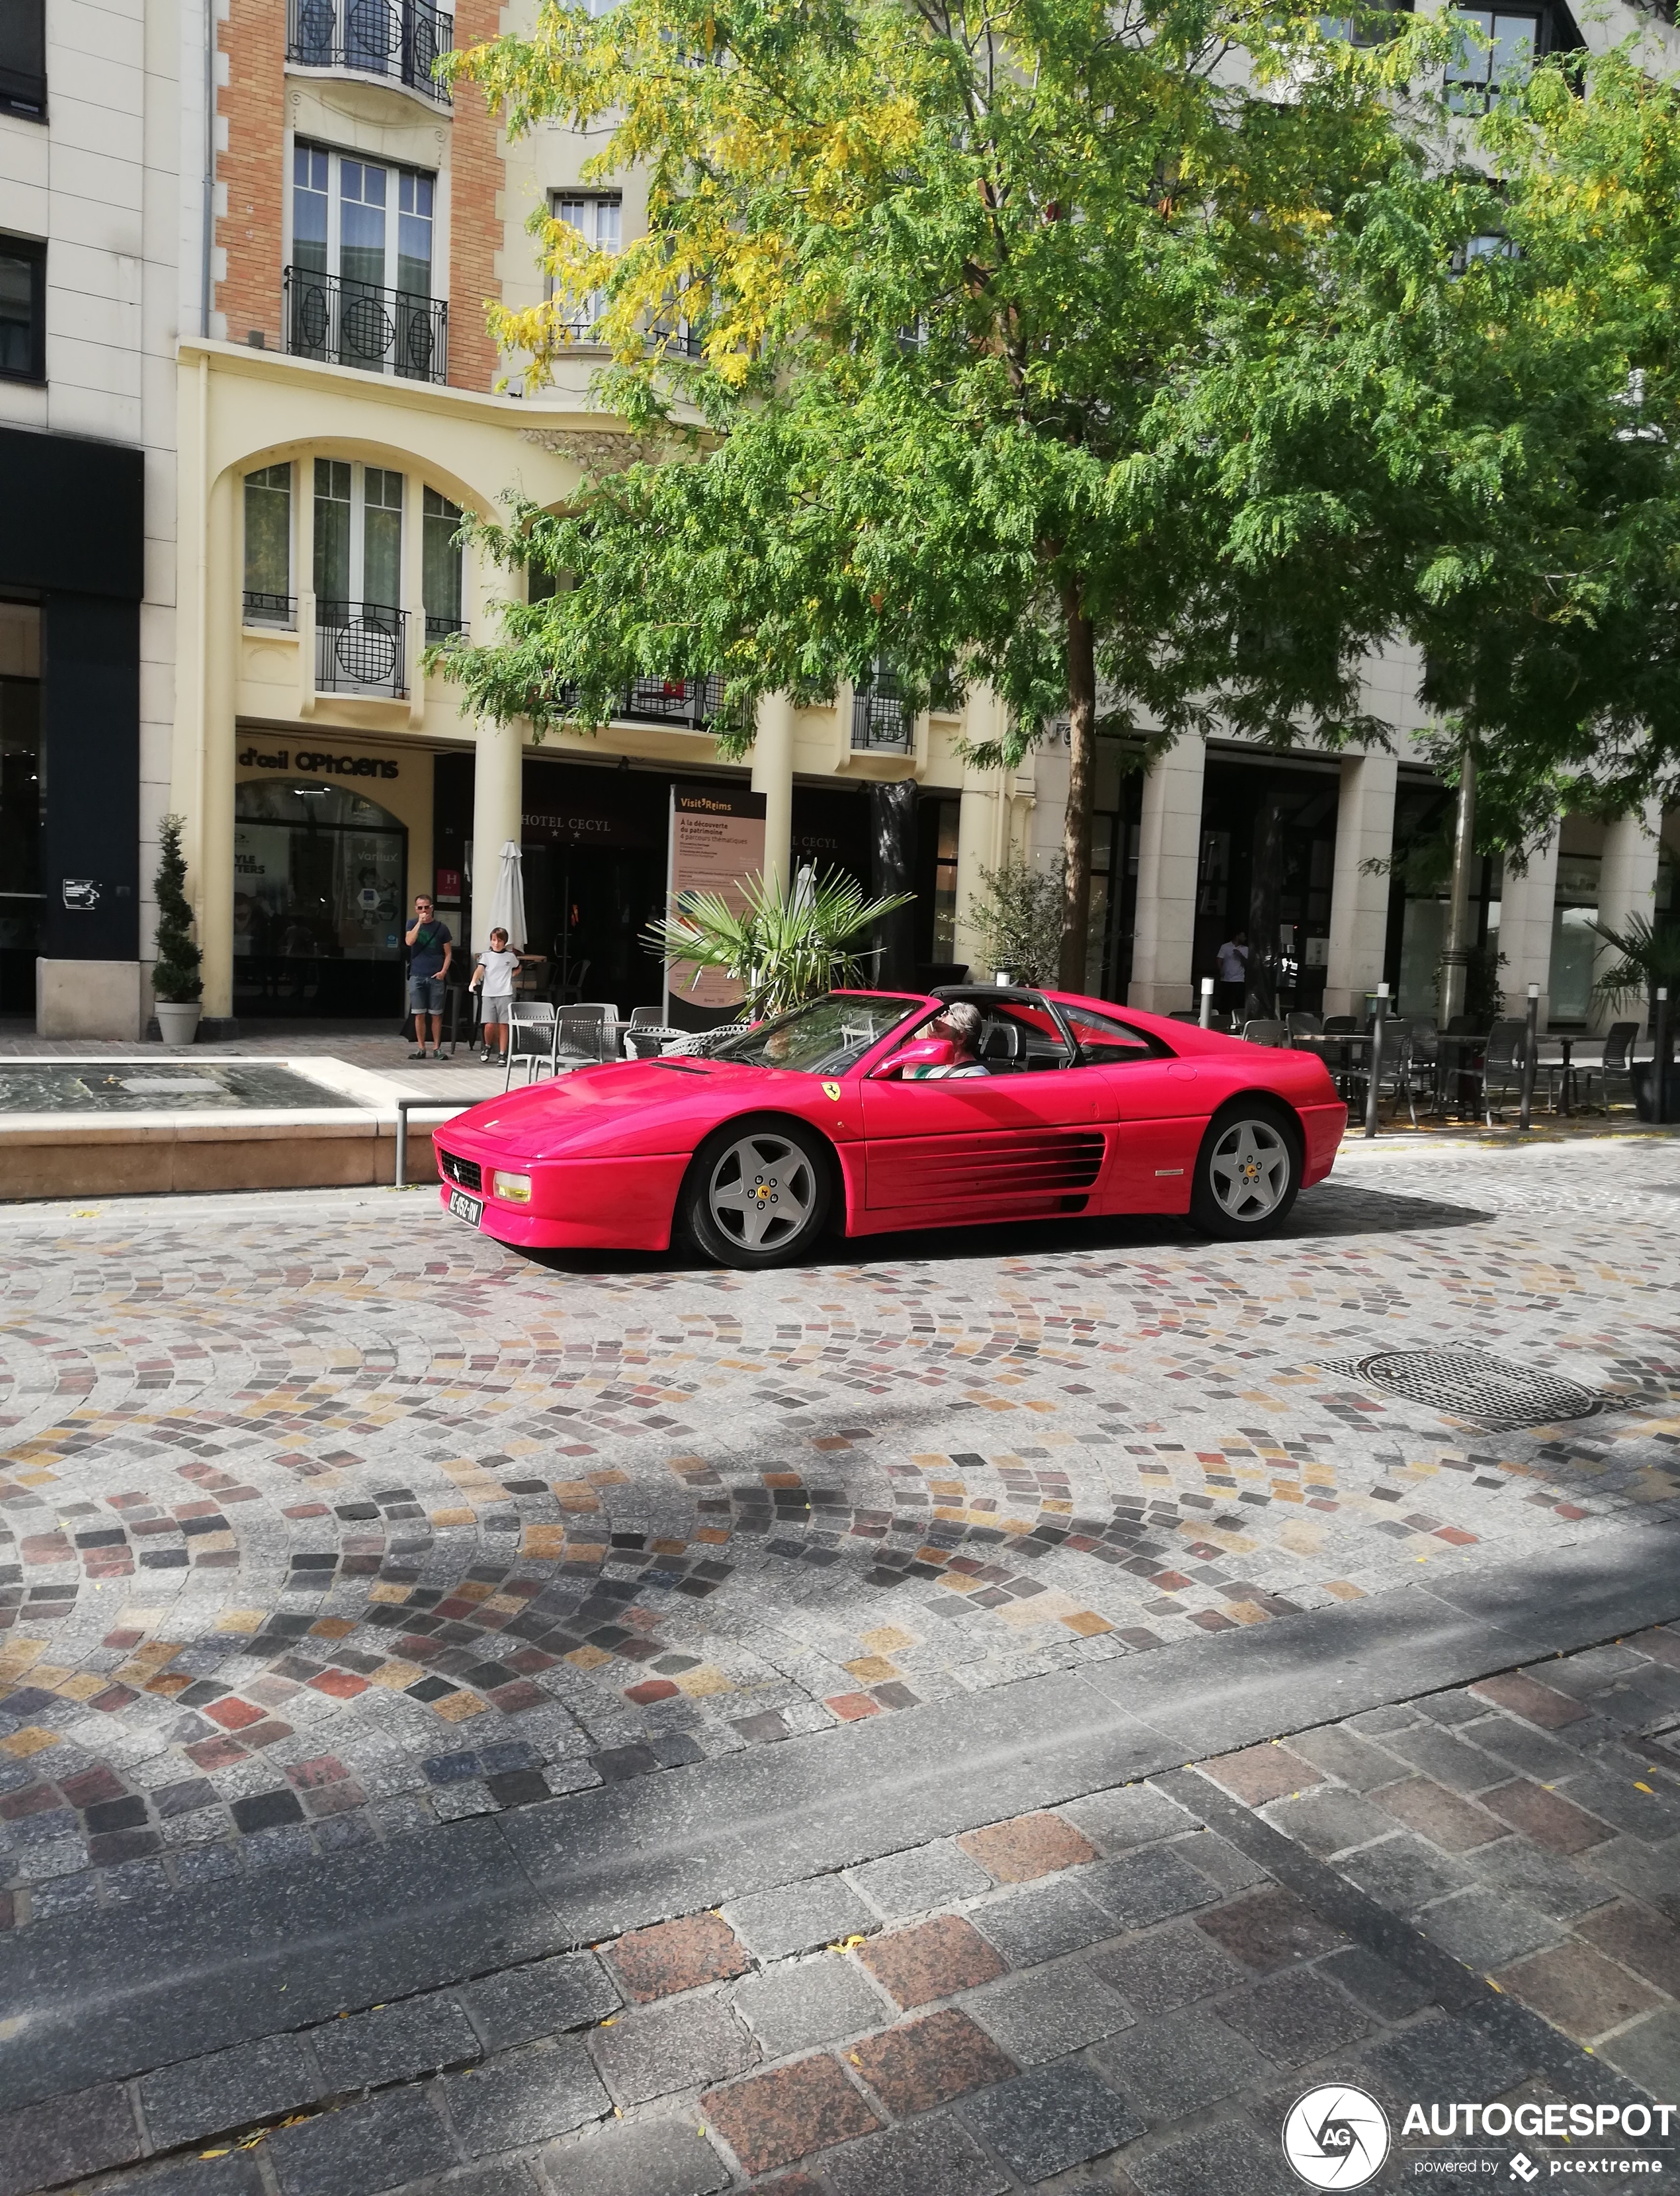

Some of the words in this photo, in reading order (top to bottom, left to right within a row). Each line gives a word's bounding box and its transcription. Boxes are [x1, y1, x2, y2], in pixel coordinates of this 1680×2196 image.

[521, 814, 564, 827] HOTEL
[568, 818, 611, 831] CECYL
[694, 820, 728, 829] découverte
[689, 827, 723, 836] patrimoine
[802, 836, 838, 849] CECYL
[446, 874, 457, 884] H
